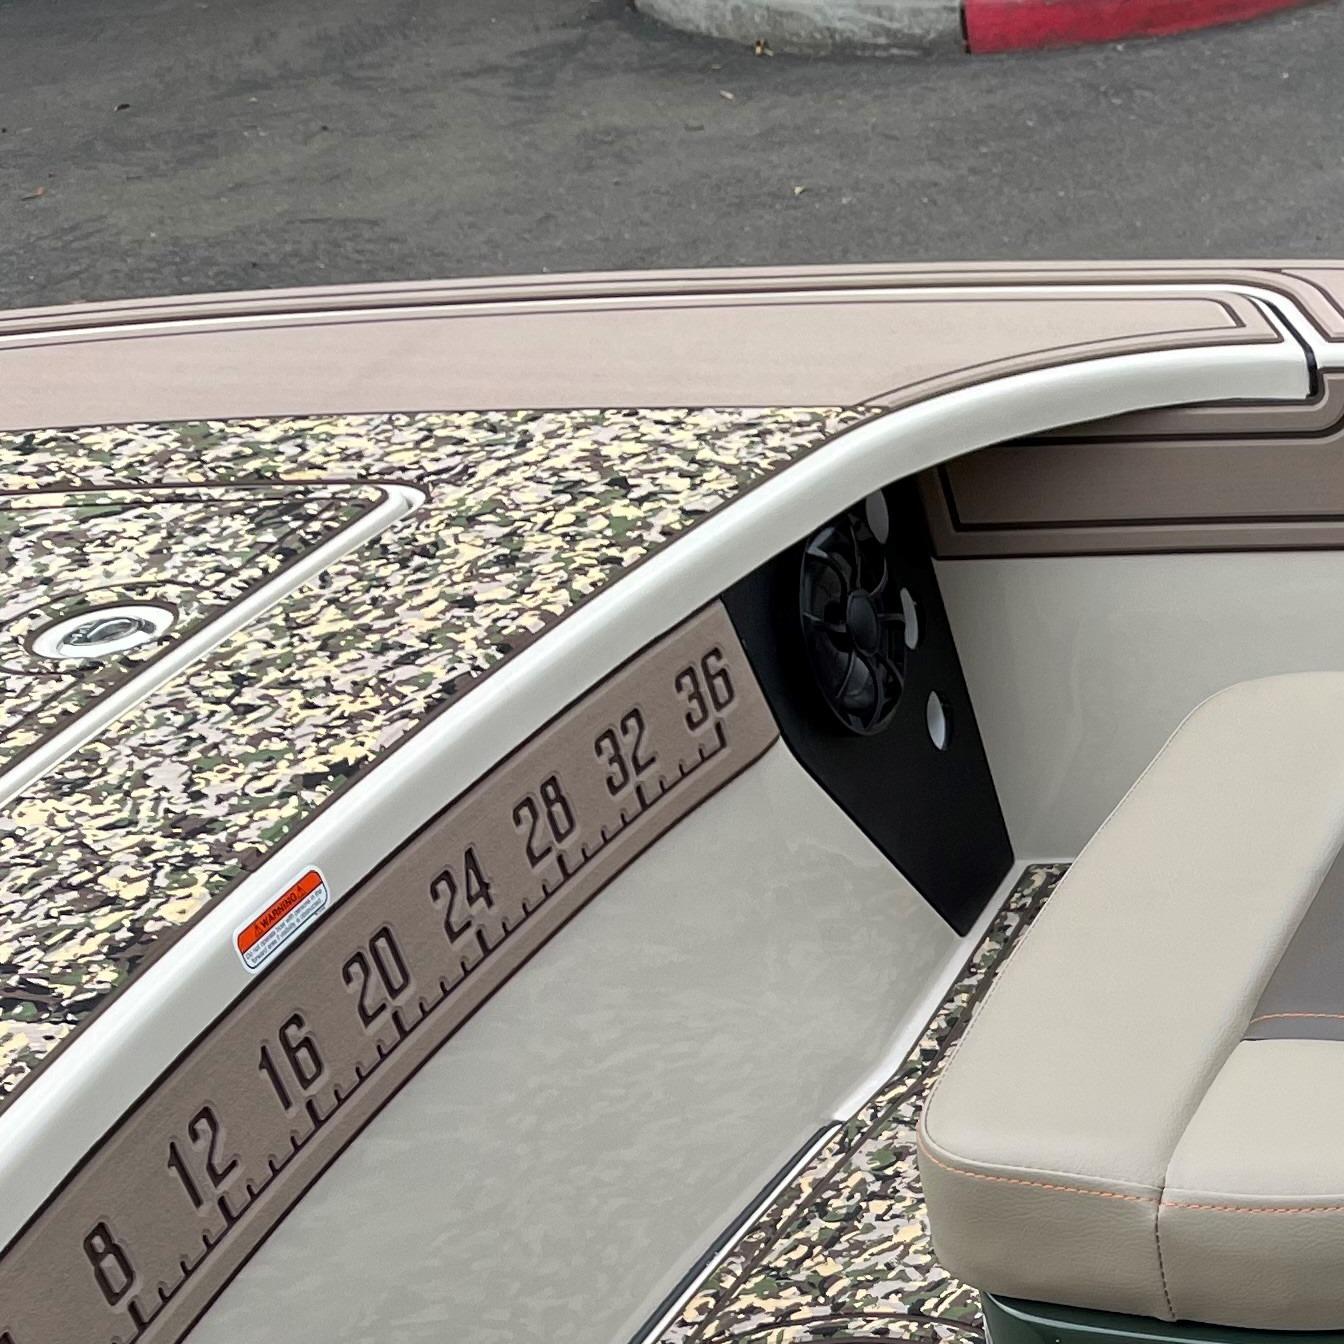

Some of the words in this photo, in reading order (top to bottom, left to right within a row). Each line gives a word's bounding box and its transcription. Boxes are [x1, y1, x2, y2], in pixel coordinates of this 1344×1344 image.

[83, 1222, 136, 1306] 8
[167, 1105, 239, 1209] 12
[258, 1012, 323, 1112] 16
[344, 924, 410, 1028] 20
[431, 848, 492, 944] 24
[512, 775, 577, 864] 28
[595, 708, 656, 795] 32
[675, 647, 735, 736] 36
[259, 892, 298, 928] WARNING
